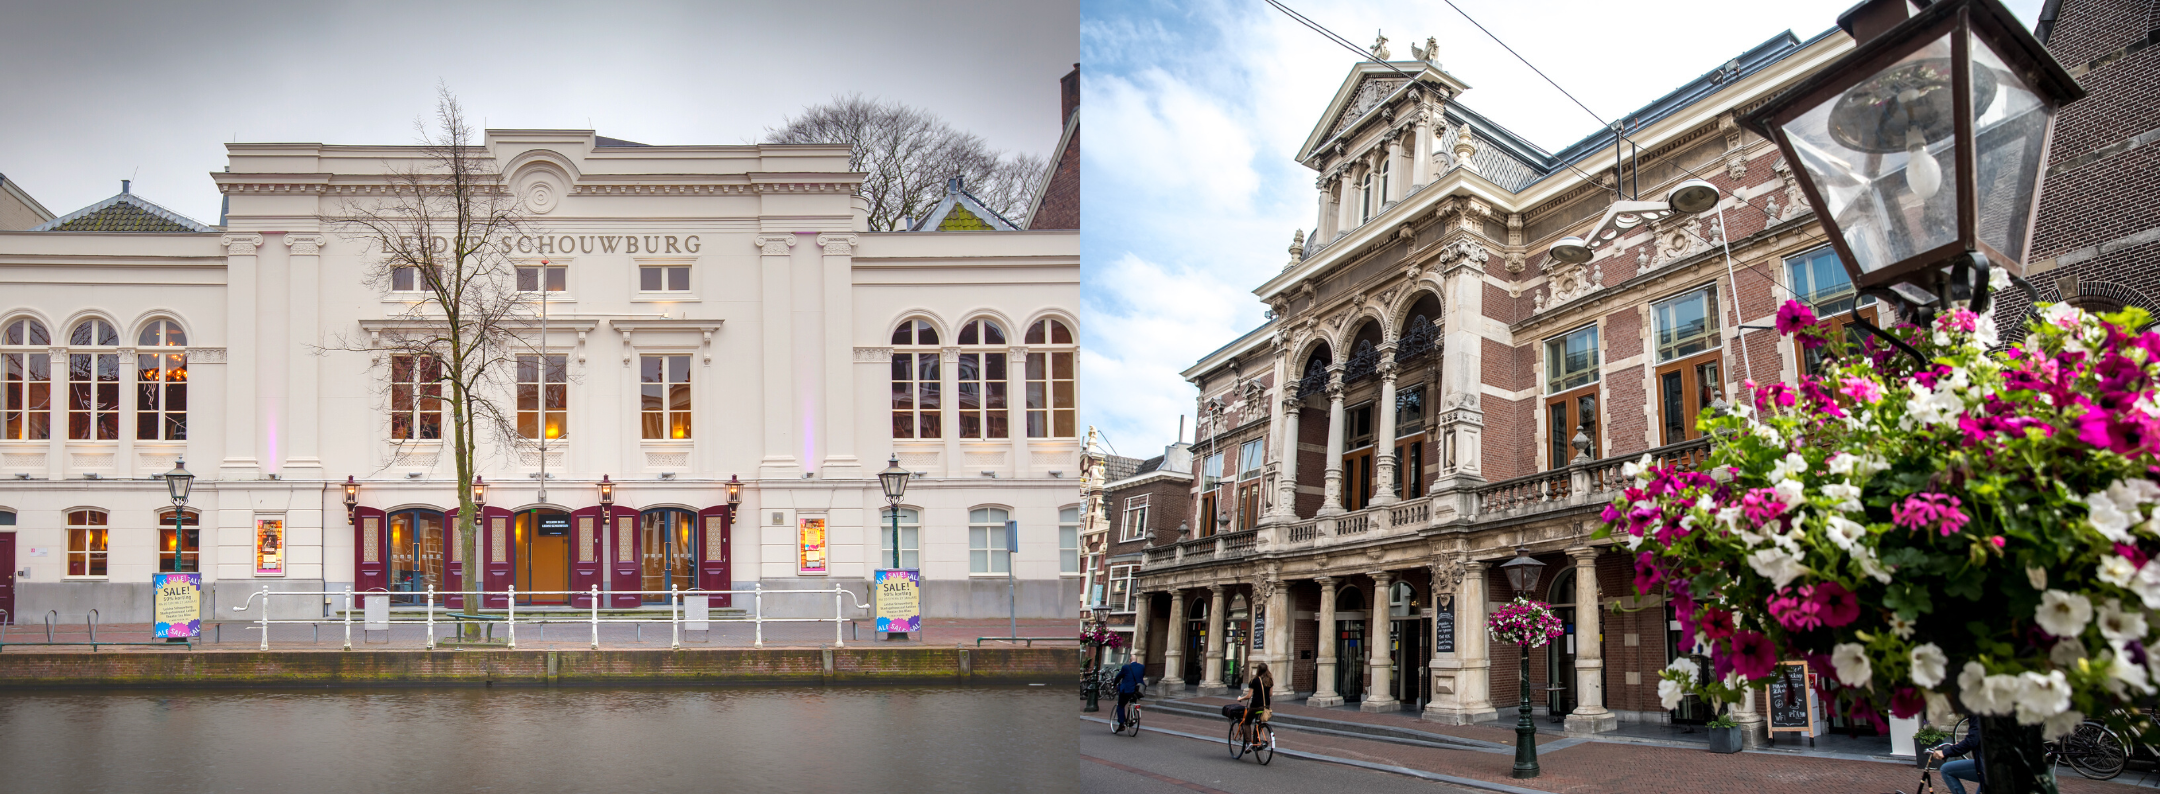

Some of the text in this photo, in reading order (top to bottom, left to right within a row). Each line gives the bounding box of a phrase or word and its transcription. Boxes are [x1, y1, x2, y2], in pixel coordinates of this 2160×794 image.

[501, 235, 701, 254] SCHOUWBURG
[169, 575, 187, 584] SALE!
[163, 586, 190, 596] SALE!
[884, 583, 910, 592] SALE!
